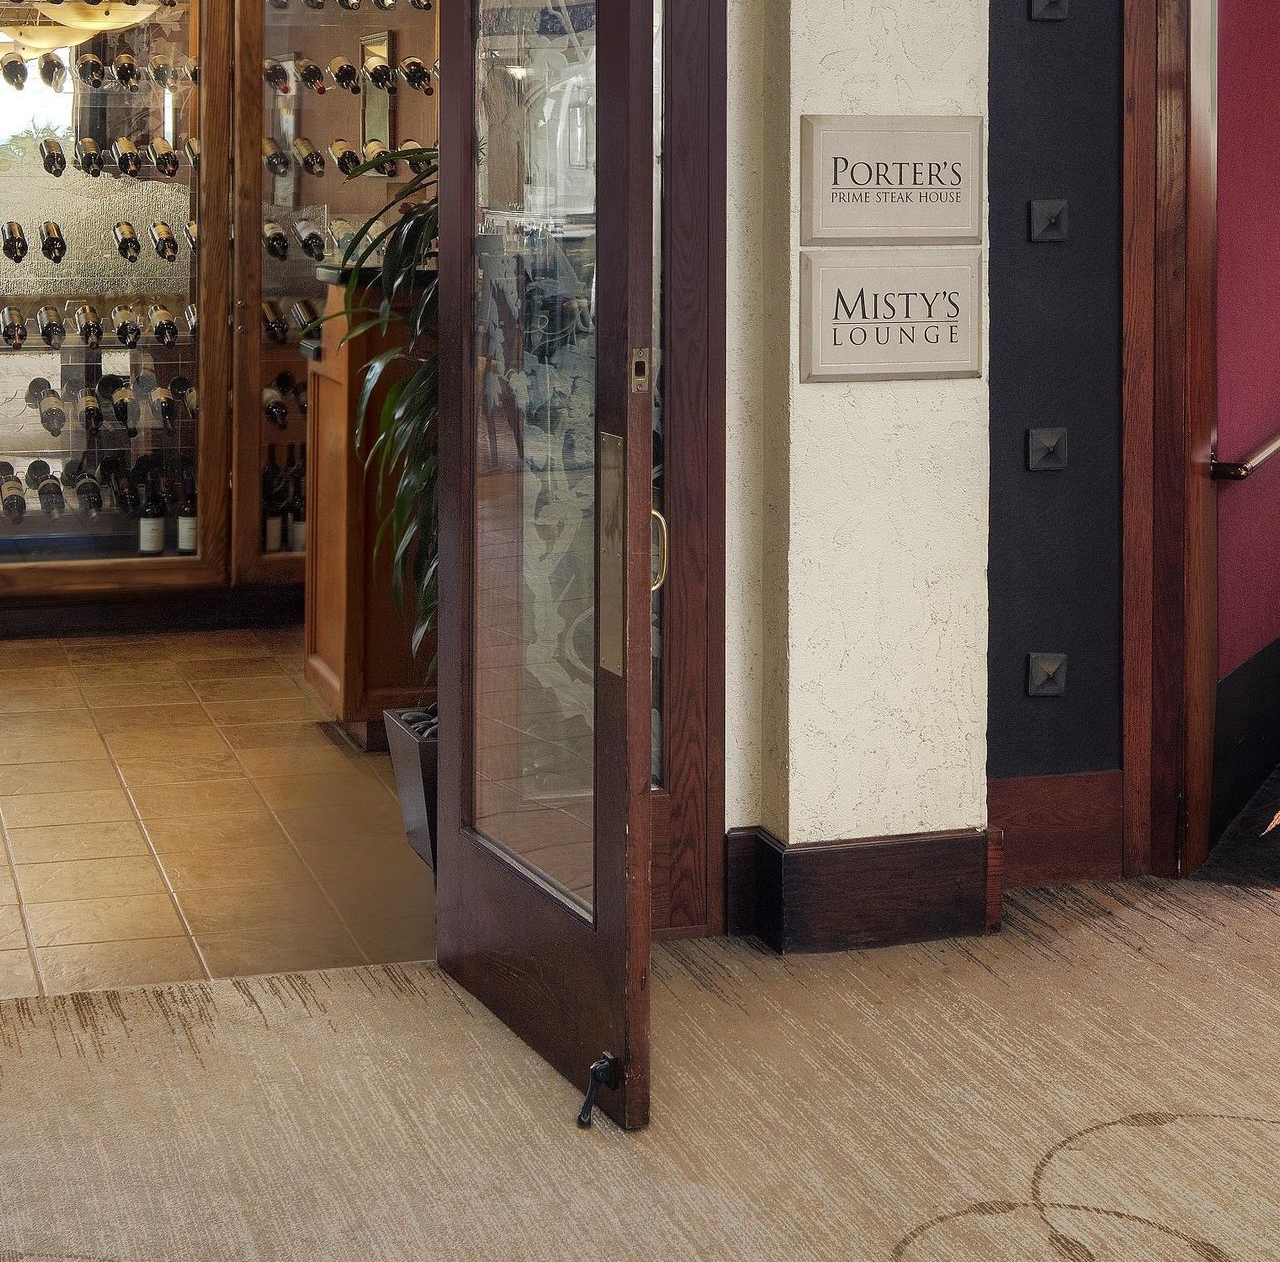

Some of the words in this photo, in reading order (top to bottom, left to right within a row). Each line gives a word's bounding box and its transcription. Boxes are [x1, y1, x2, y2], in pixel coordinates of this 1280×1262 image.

[832, 157, 962, 186] PORTER'S
[831, 192, 870, 203] PRIME
[876, 192, 913, 203] STEAK
[919, 192, 961, 203] HOUSE
[832, 287, 960, 320] MISTY'S
[832, 325, 959, 346] LOUNGE
